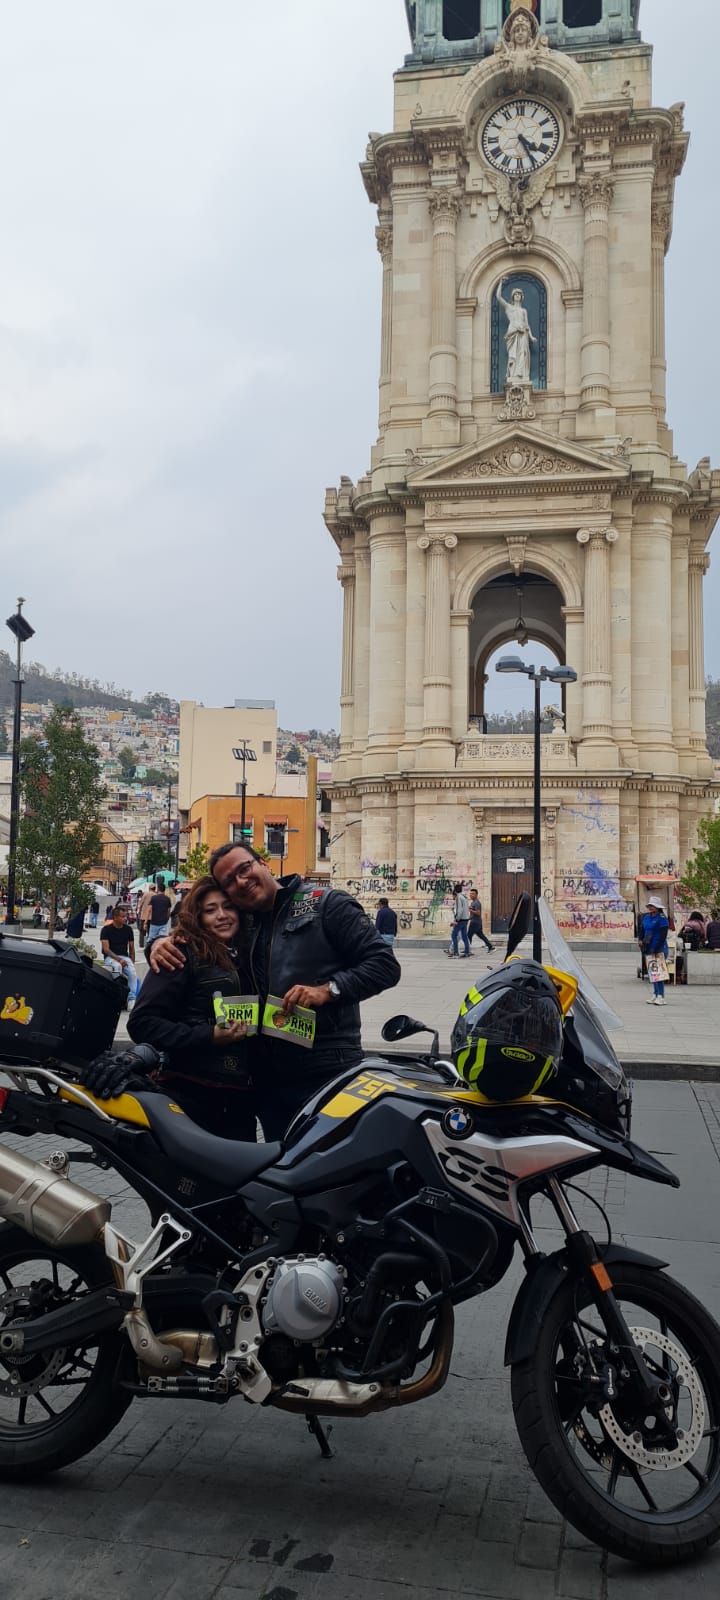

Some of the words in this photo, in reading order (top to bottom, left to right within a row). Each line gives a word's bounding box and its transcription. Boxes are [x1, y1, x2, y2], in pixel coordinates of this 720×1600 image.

[229, 1009, 253, 1020] RRM
[290, 1017, 312, 1035] RRM
[437, 1146, 519, 1201] GS
[304, 1288, 327, 1309] BMW
